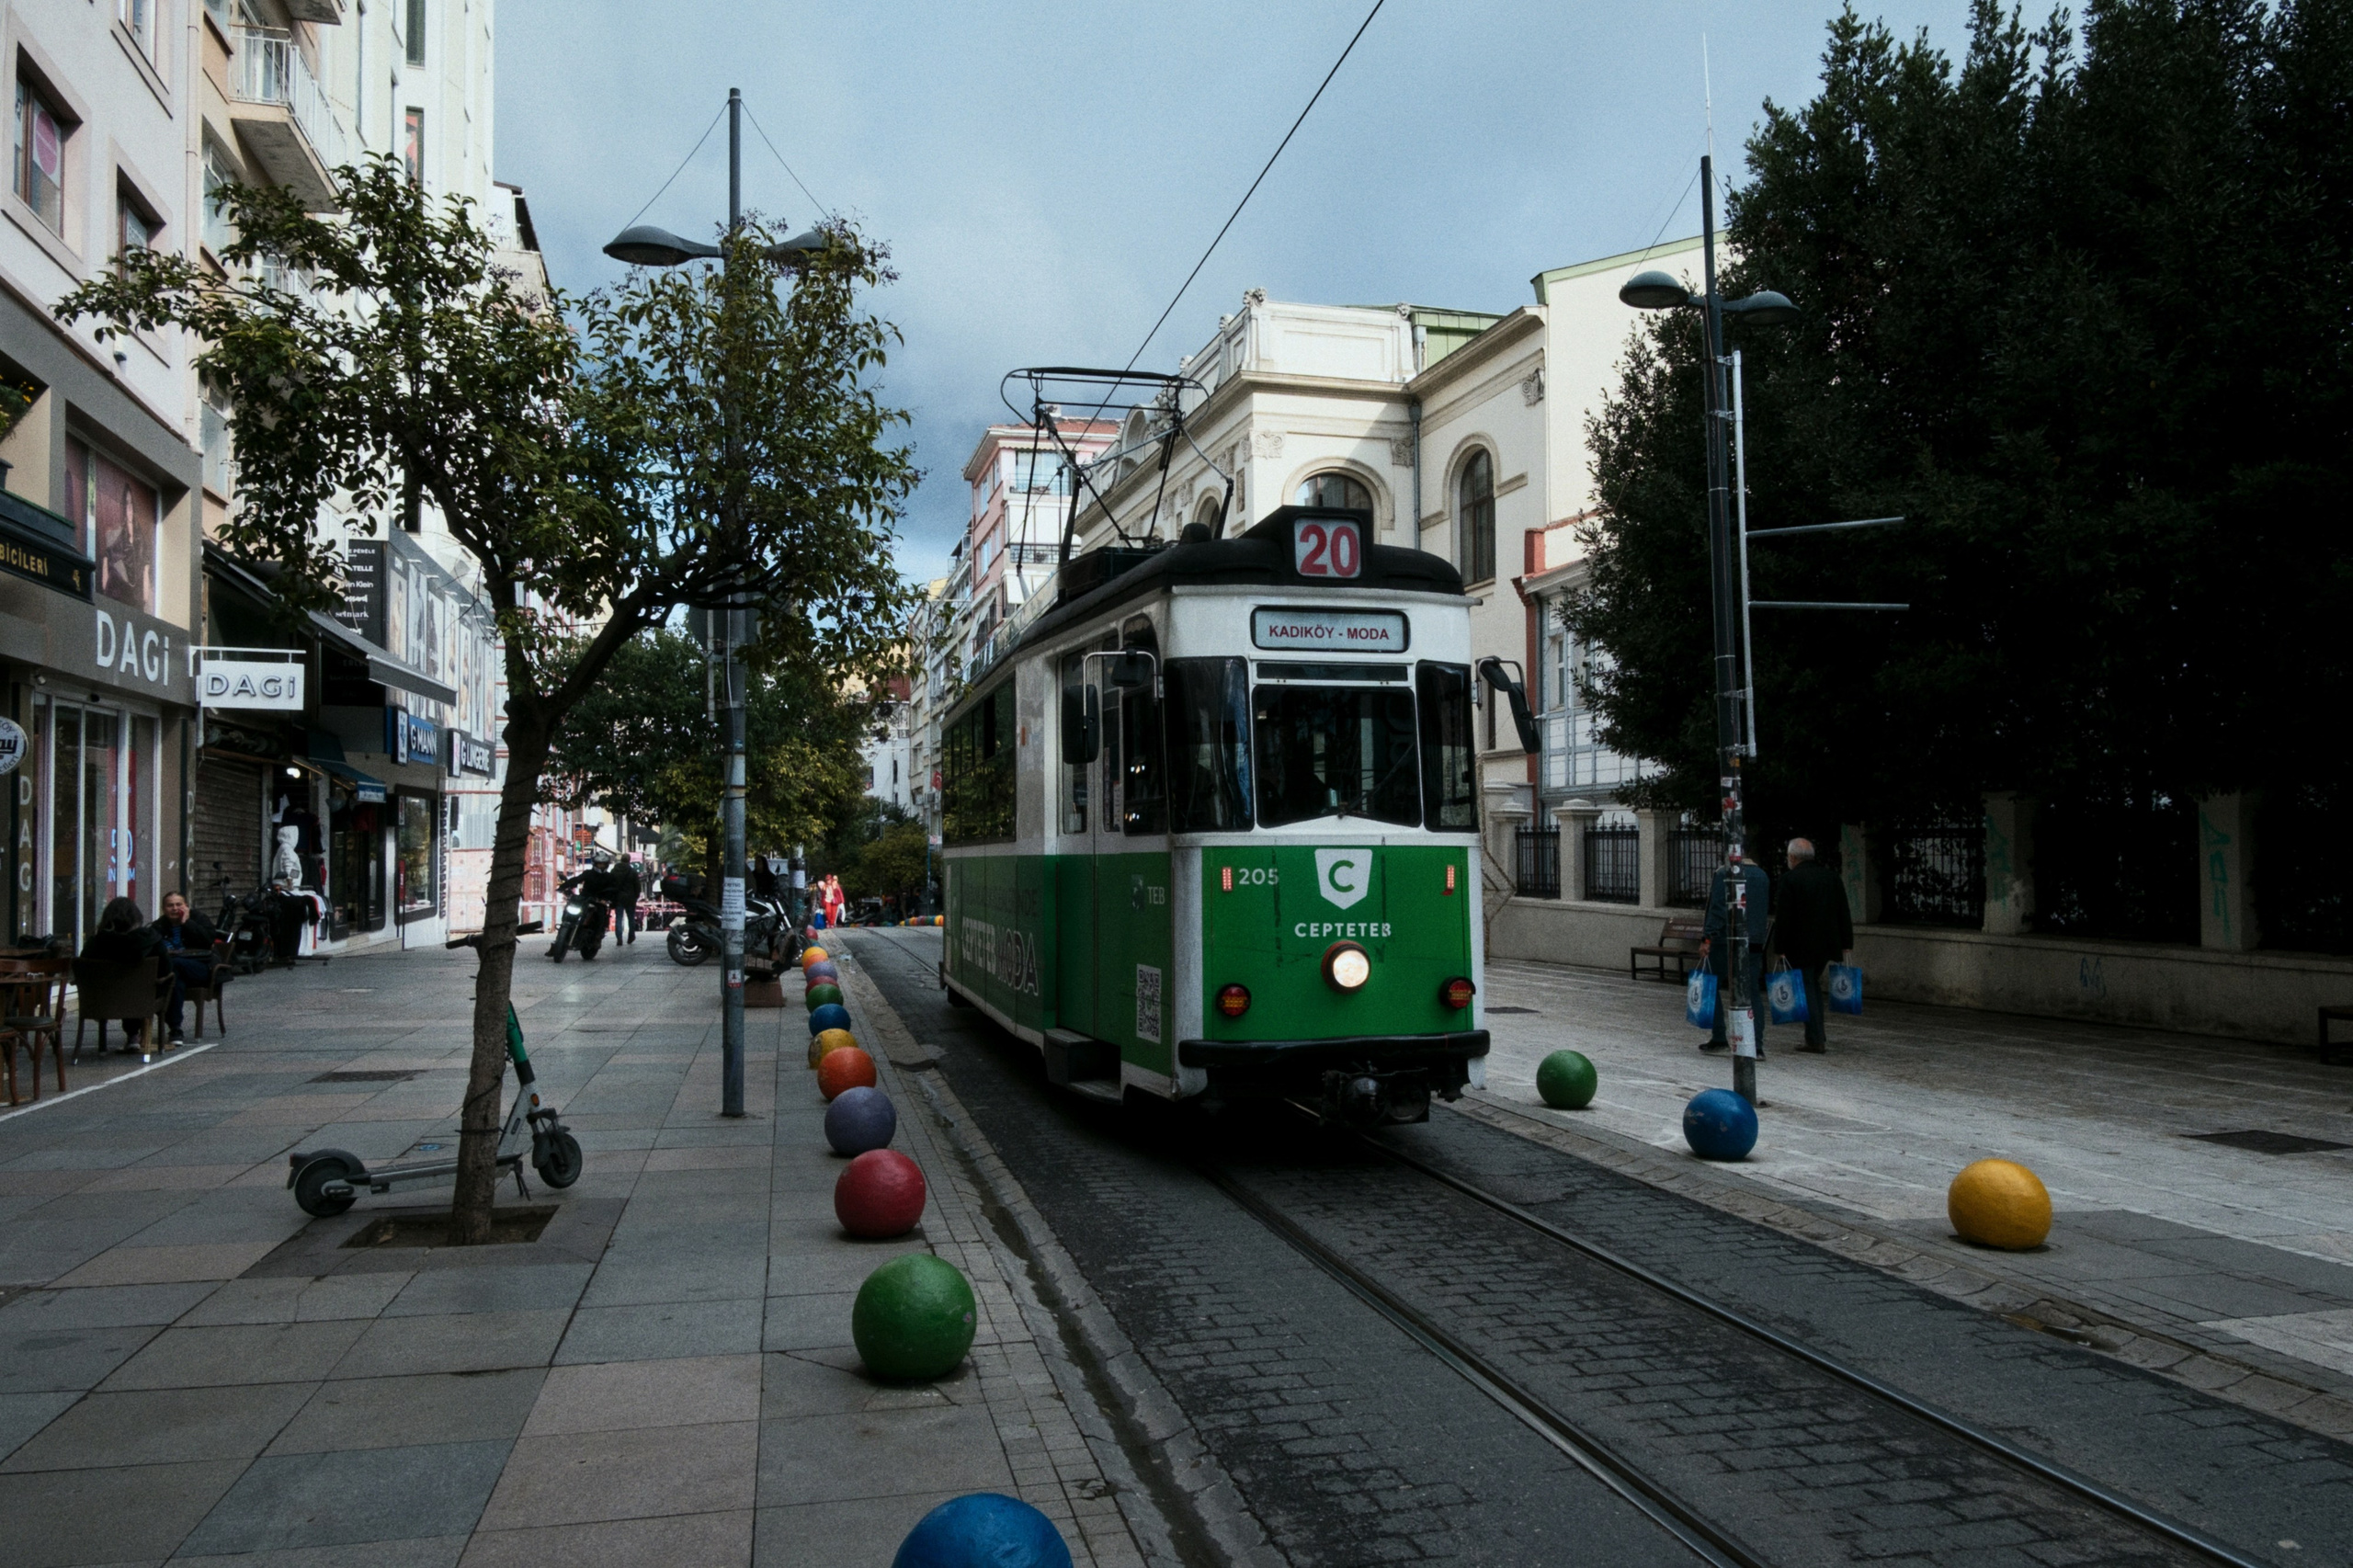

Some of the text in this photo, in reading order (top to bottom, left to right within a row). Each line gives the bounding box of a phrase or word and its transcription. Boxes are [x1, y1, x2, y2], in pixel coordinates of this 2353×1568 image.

[1299, 524, 1359, 577] 20
[1268, 624, 1335, 639] KADIKÖY
[1347, 628, 1390, 641] MODA
[417, 727, 438, 756] MANN
[1238, 868, 1279, 885] 205
[1328, 859, 1356, 893] C
[1147, 886, 1165, 904] TEB
[1294, 922, 1392, 937] CEPTETEB
[996, 924, 1040, 996] MODA
